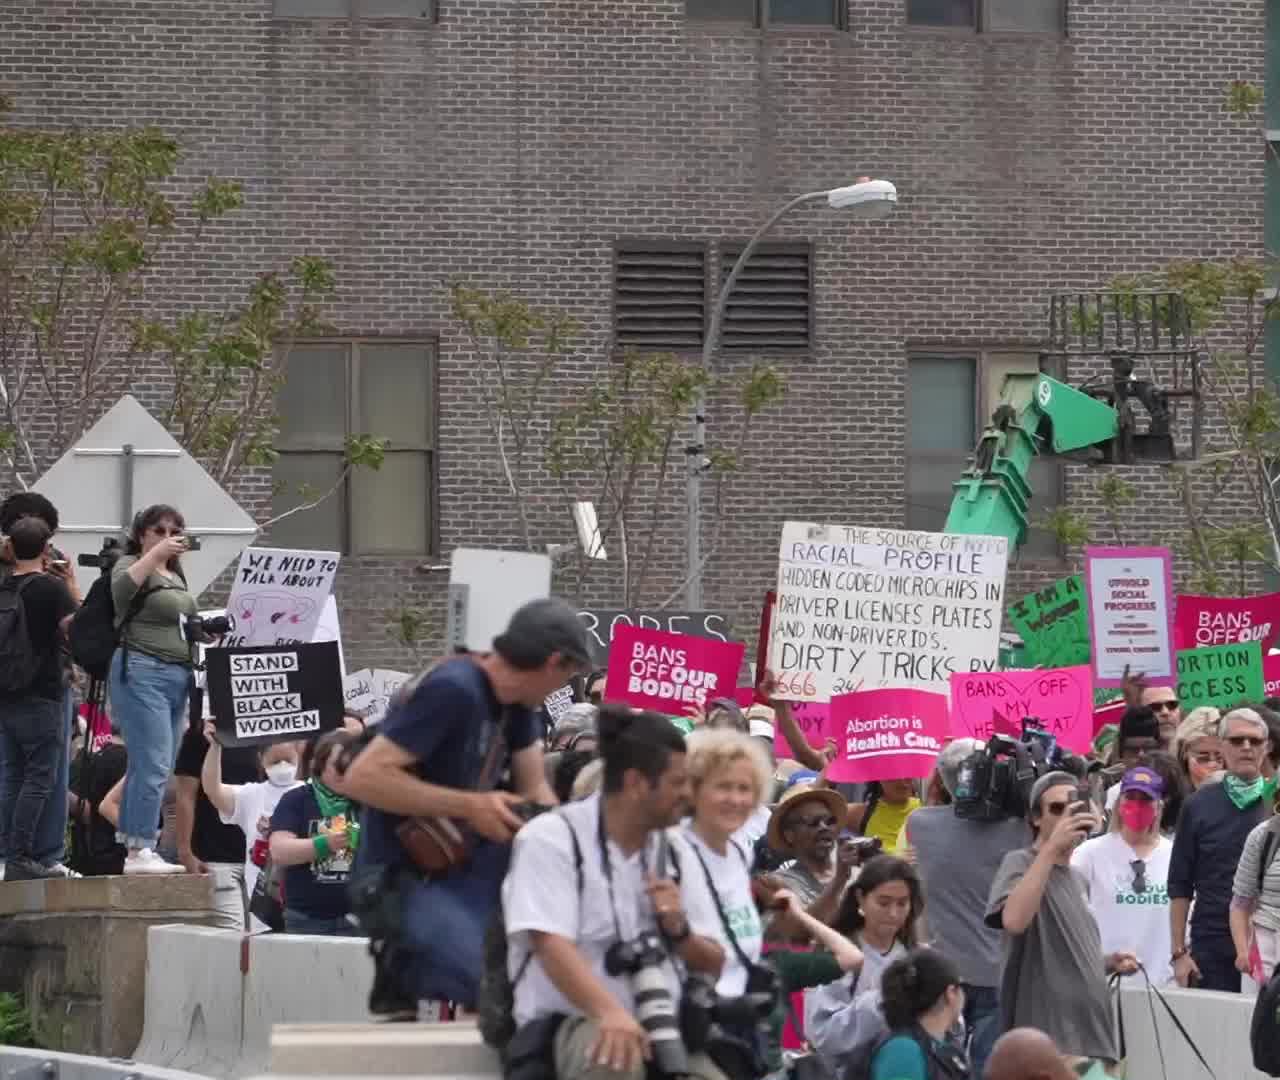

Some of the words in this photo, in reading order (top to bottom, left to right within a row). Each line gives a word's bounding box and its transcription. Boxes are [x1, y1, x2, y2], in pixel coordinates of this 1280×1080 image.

[843, 527, 872, 545] THE
[877, 530, 932, 550] SOURCE
[940, 533, 958, 550] OF
[249, 554, 272, 571] WE
[320, 560, 336, 572] TO
[792, 543, 864, 566] RACIAL
[884, 548, 983, 574] PROFILE
[242, 568, 276, 585] TALK
[282, 575, 324, 588] ABOUT
[782, 568, 831, 590] HIDDEN
[836, 571, 884, 593] CODED
[888, 575, 977, 600] MICROCHIPS
[986, 583, 1001, 601] IN
[779, 594, 839, 618] DRIVER
[844, 599, 922, 626] LICENSES
[932, 604, 993, 629] PLATES
[1198, 611, 1252, 628] BANS
[776, 622, 805, 639] AND
[813, 623, 906, 647] NON-DRIVER
[1196, 628, 1236, 643] OFF
[1238, 622, 1272, 643] OUR
[233, 656, 295, 672] STAND
[633, 642, 687, 667] BANS
[780, 642, 866, 673] DIRTY
[879, 650, 957, 681] TRICKS
[1176, 650, 1250, 674] ORTION
[630, 658, 669, 680] OFF
[670, 667, 718, 690] OUR
[235, 678, 284, 693] WITH
[628, 676, 708, 705] BODIES
[966, 678, 1006, 697] BANS
[1039, 678, 1068, 696] OFF
[1176, 676, 1247, 700] CCESS
[236, 696, 299, 715] BLACK
[1005, 698, 1032, 716] MY
[238, 713, 317, 734] WOMEN
[846, 716, 908, 735] Abortion
[912, 714, 922, 730] is
[846, 733, 900, 753] Health
[904, 731, 942, 750] Care.
[1116, 894, 1168, 904] BODIES
